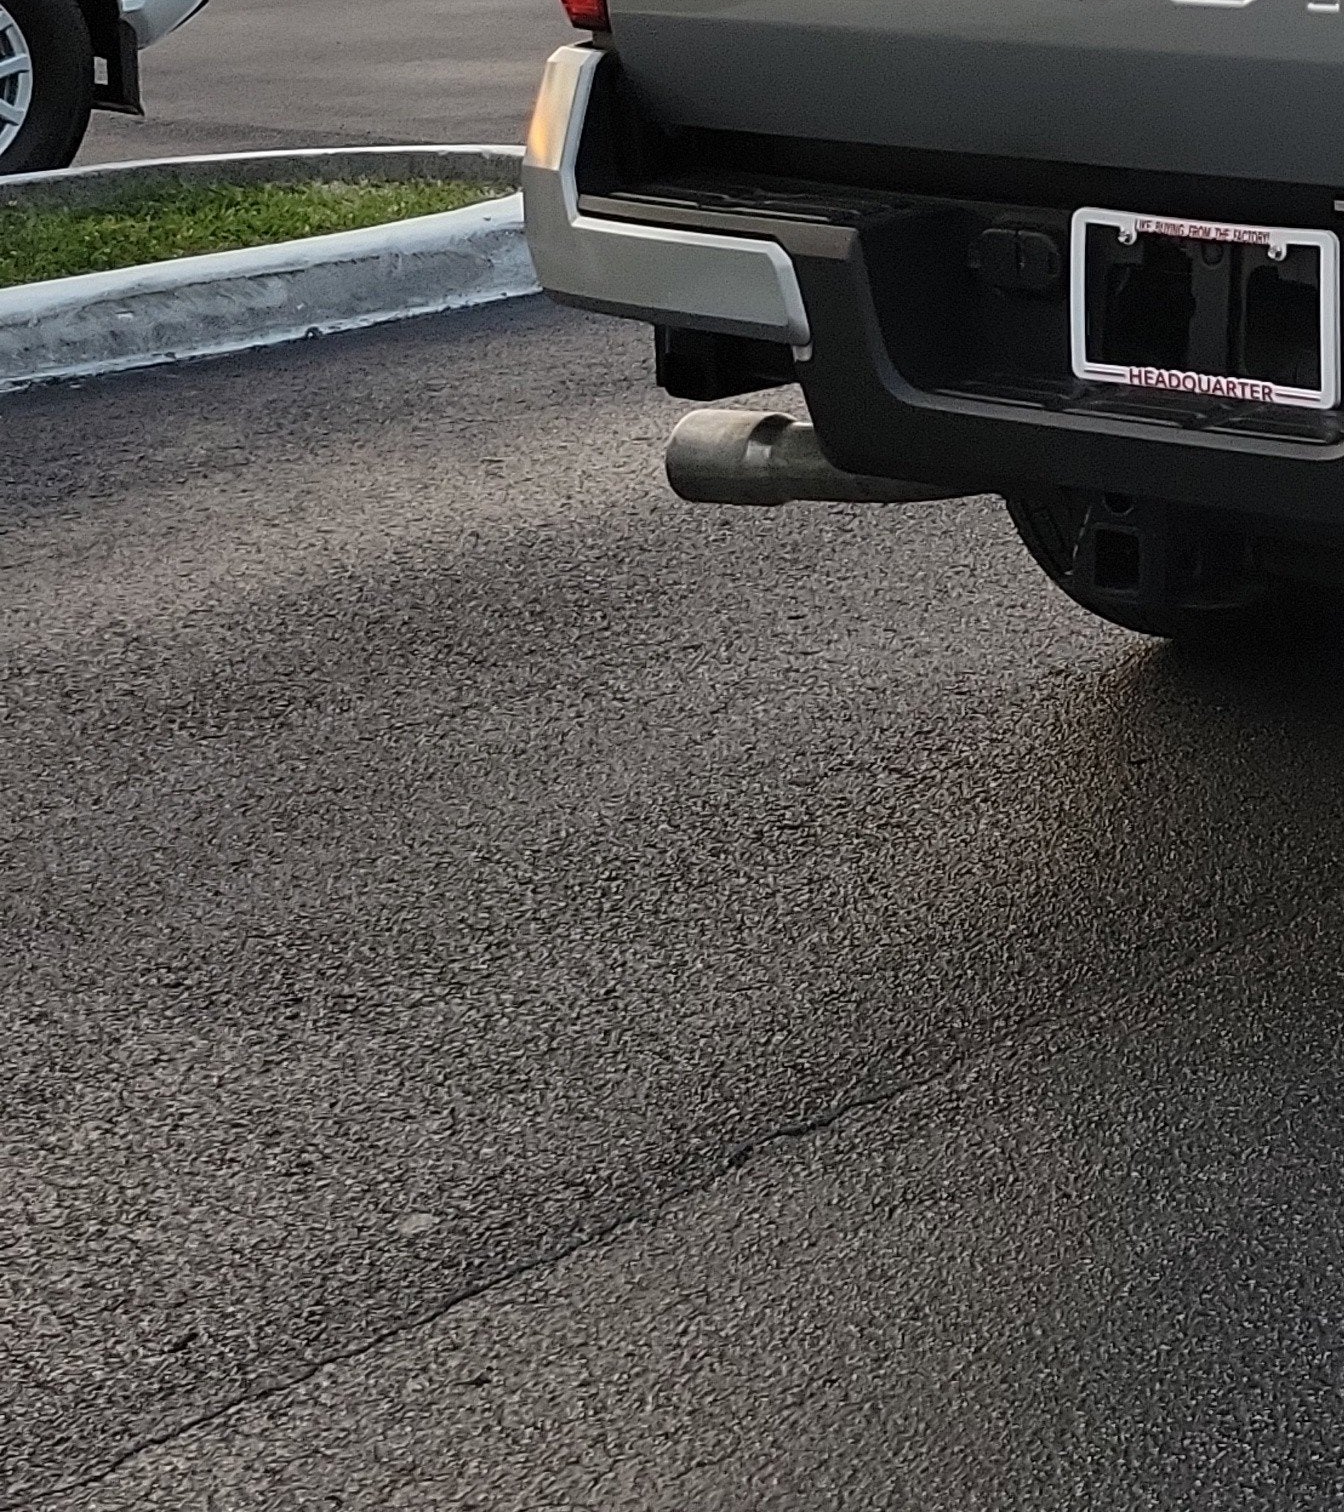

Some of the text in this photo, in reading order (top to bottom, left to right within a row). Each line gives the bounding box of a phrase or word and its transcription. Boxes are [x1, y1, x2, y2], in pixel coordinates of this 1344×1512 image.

[1155, 220, 1184, 236] BUYING
[1188, 224, 1212, 238] FROM
[1214, 227, 1230, 239] THE
[1128, 368, 1274, 402] HEADQUARTER
